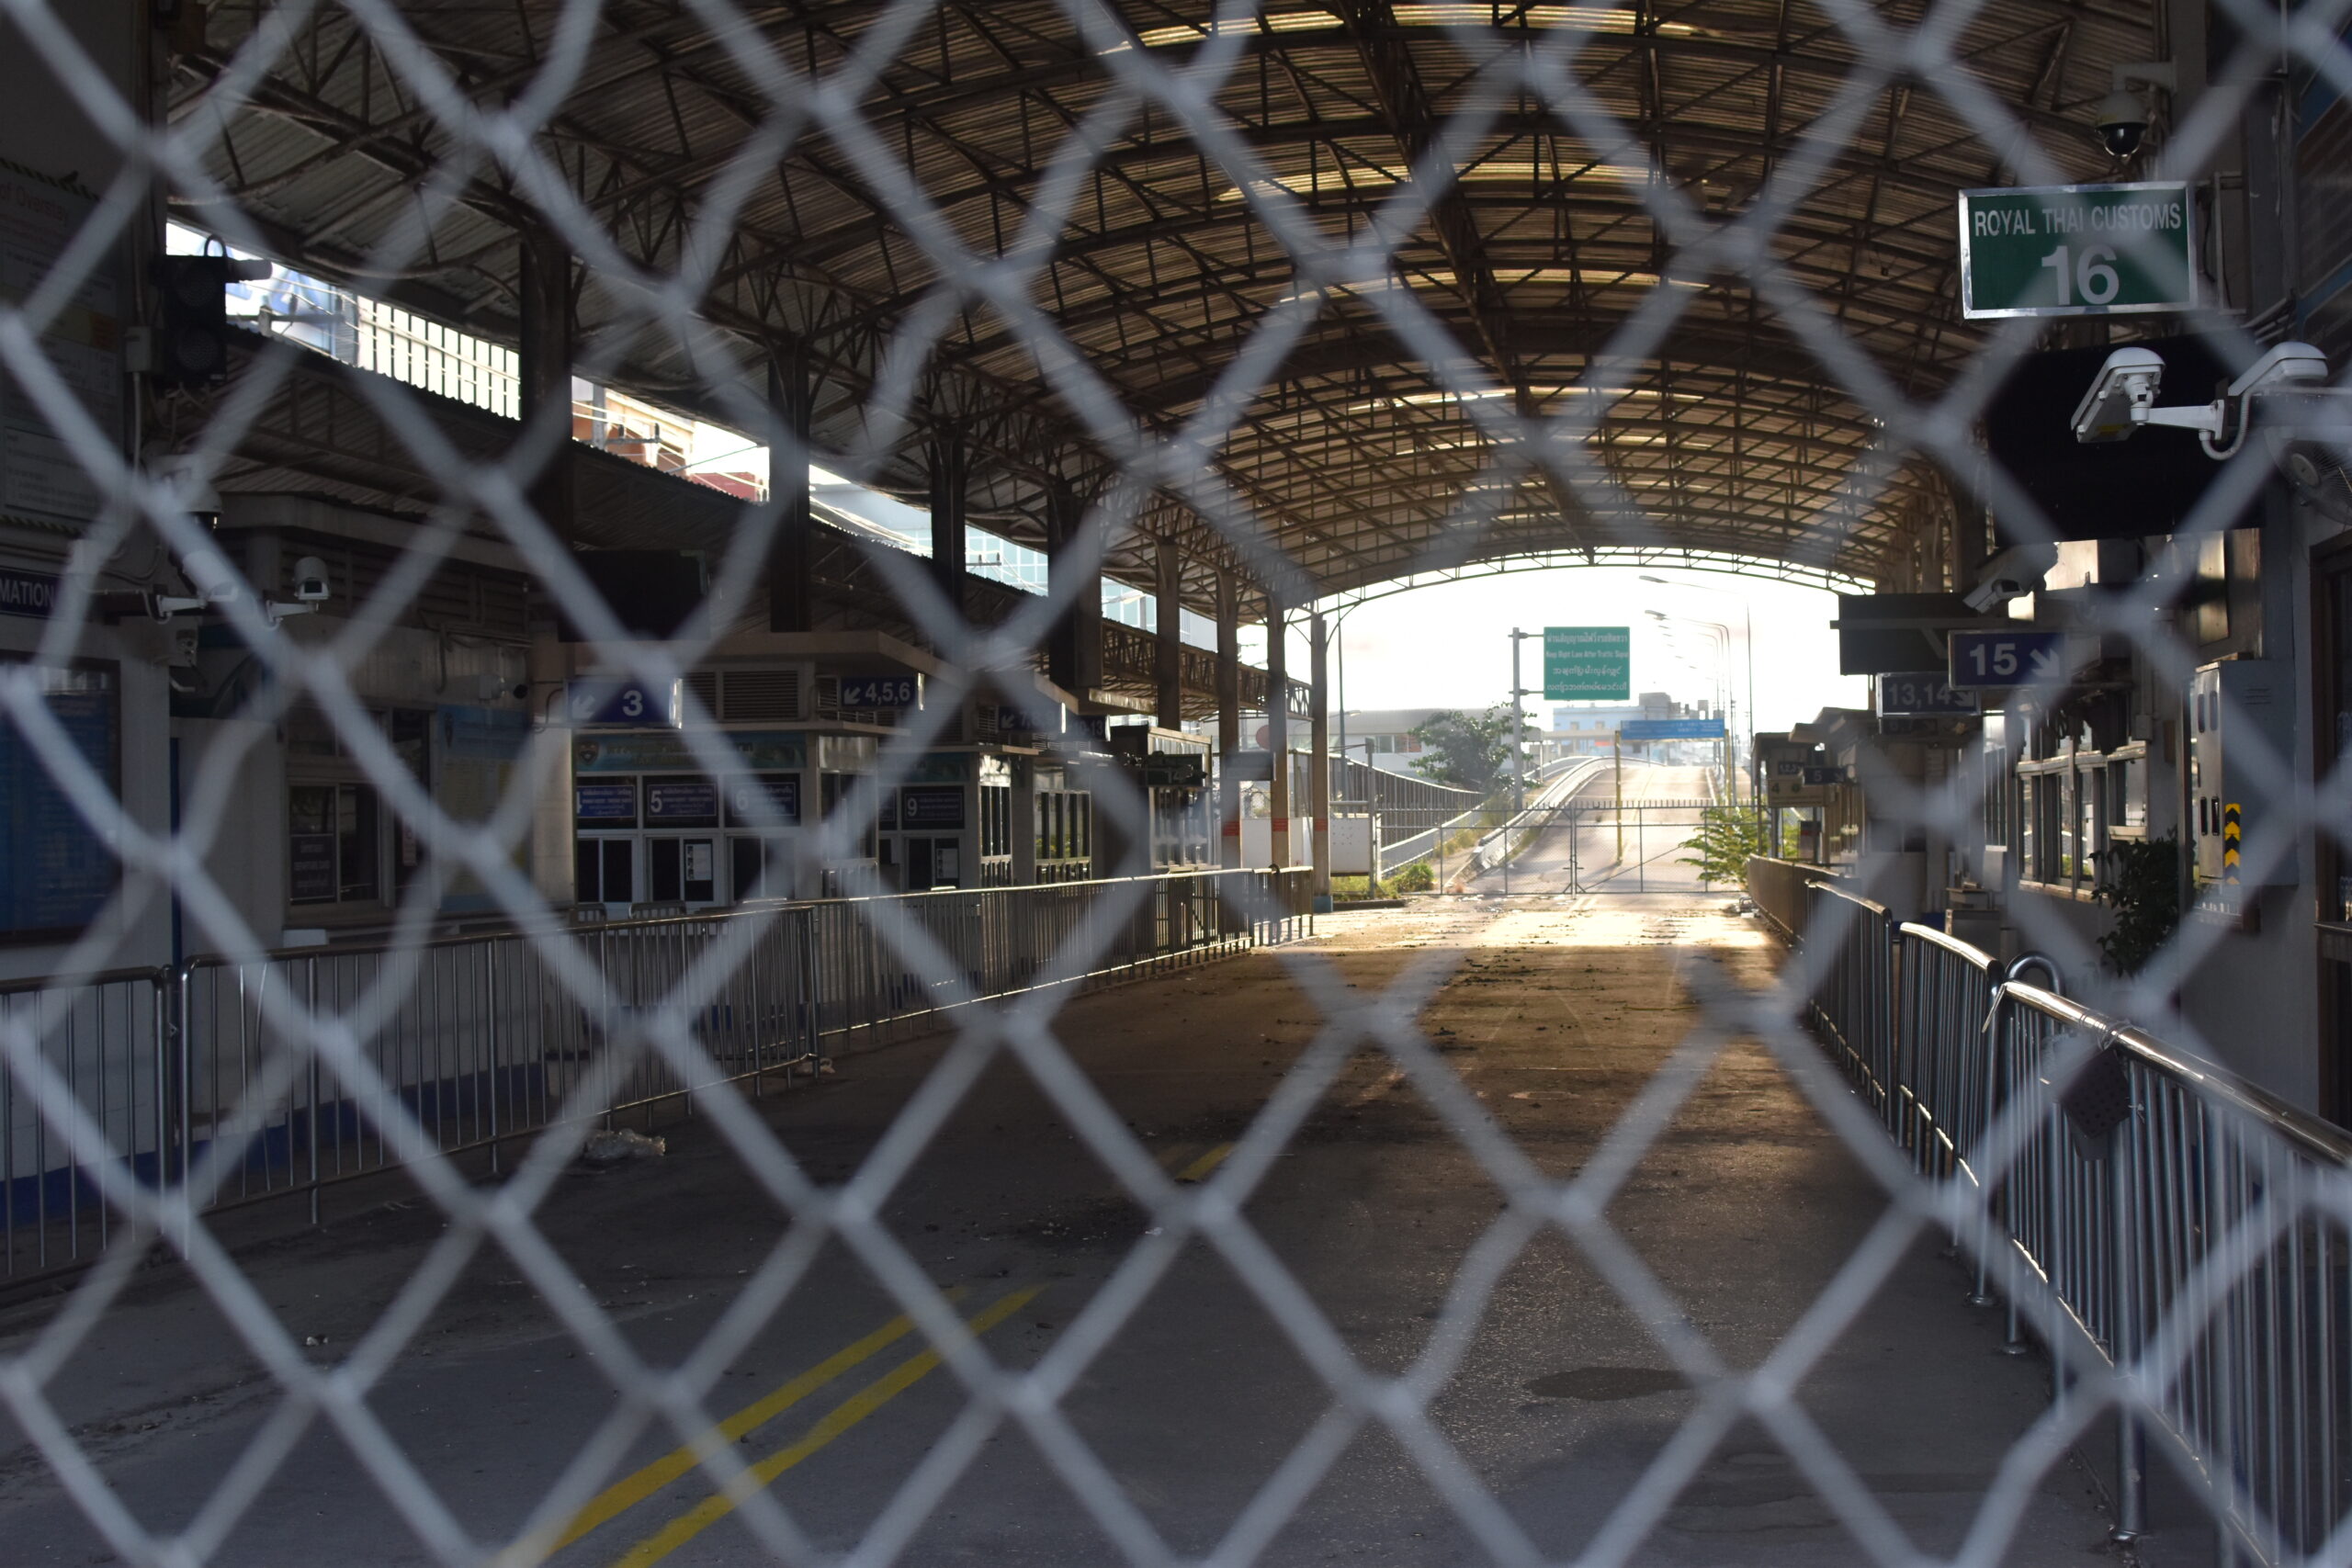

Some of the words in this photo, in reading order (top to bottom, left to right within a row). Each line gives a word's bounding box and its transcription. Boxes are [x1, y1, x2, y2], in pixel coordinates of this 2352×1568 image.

[16, 186, 69, 227] Overstay
[1974, 209, 2036, 237] ROYAL
[2041, 206, 2084, 234] THAI
[2091, 202, 2182, 231] CUSTOMS
[2041, 243, 2120, 306] 16
[1969, 642, 2018, 676] 15
[621, 690, 644, 716] 3
[865, 681, 911, 705] 4,5,6
[1888, 682, 1951, 709] 13,14
[1814, 769, 1823, 782] 5
[650, 789, 662, 814] 5
[736, 788, 750, 811] 6
[907, 796, 918, 817] 9
